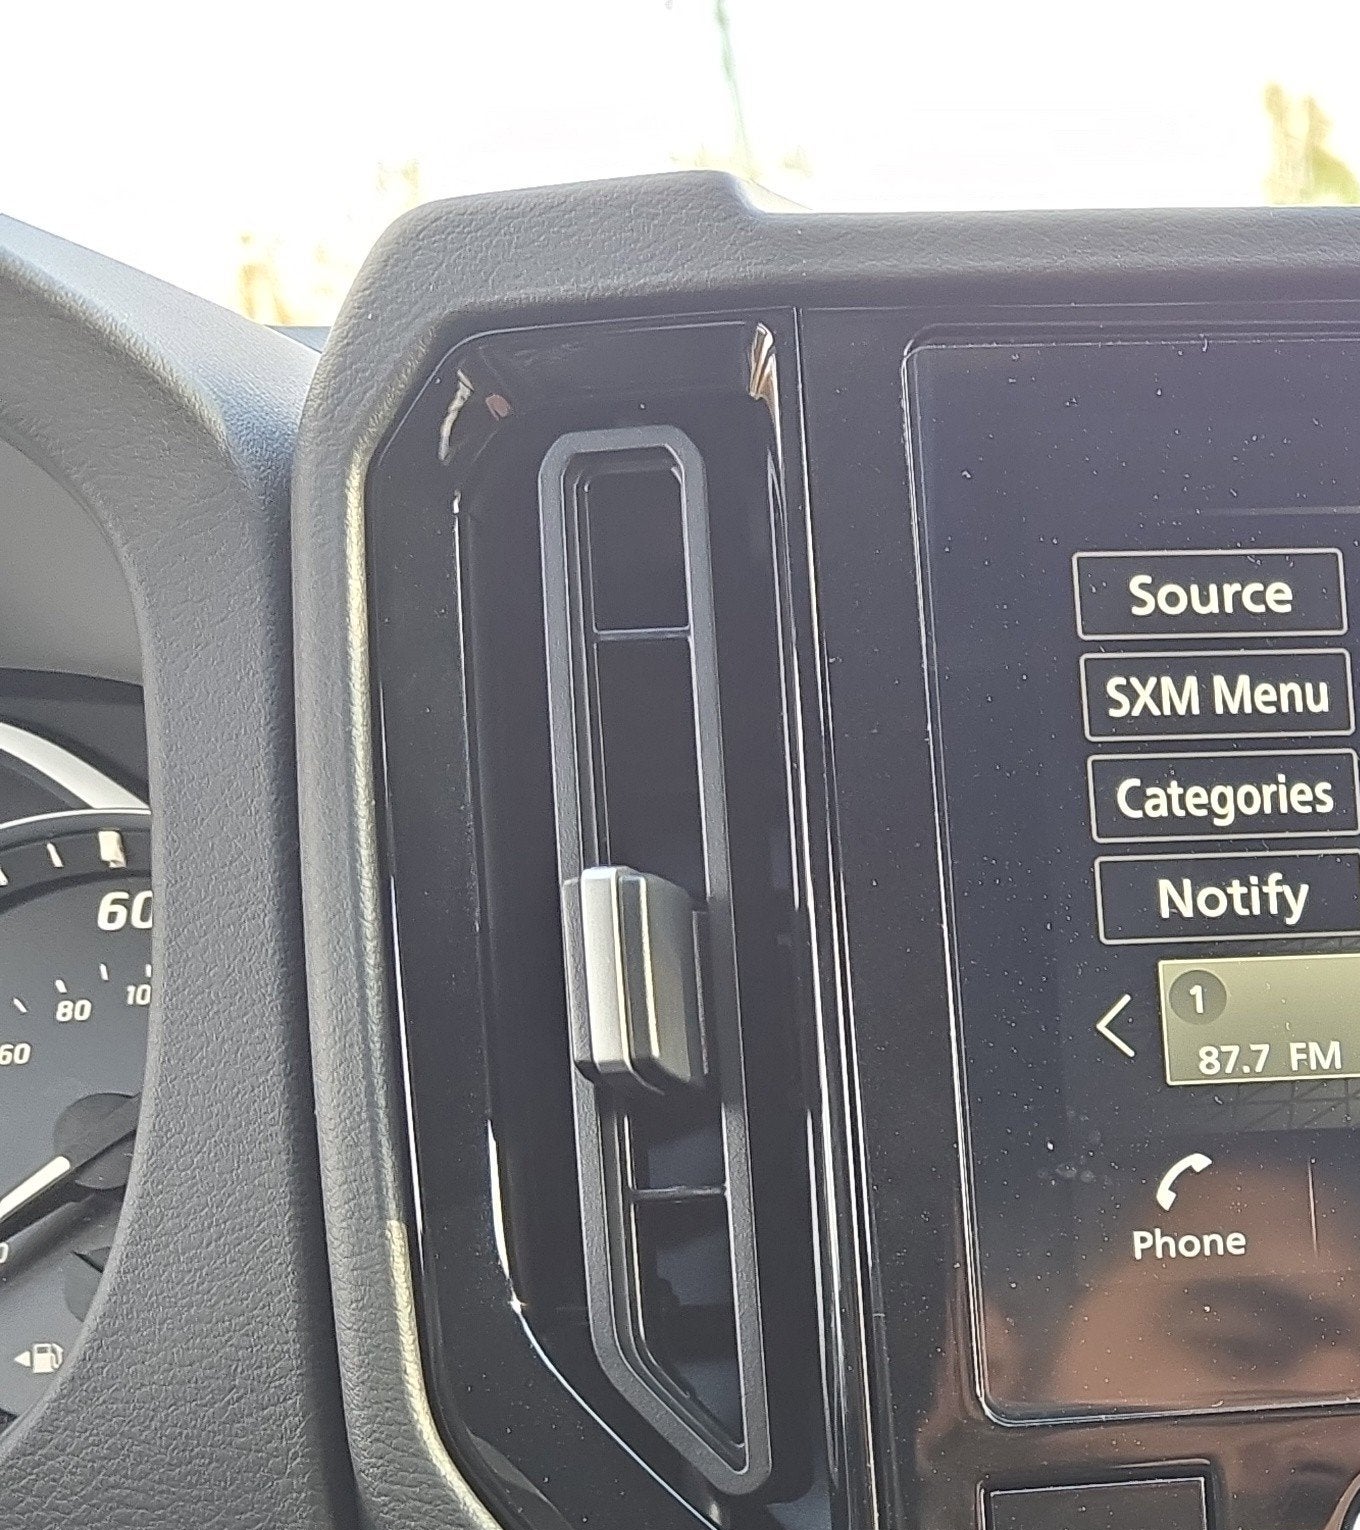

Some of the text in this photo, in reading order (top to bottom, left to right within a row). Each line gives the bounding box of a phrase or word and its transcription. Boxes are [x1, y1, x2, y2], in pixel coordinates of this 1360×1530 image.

[1129, 574, 1294, 617] Source
[1106, 674, 1330, 718] SXM Menu
[1116, 775, 1334, 826] Categories
[97, 890, 153, 931] 60
[1159, 873, 1310, 924] Notify
[56, 999, 92, 1022] 80
[126, 983, 151, 1006] 10
[1189, 985, 1203, 1014] 1
[0, 1043, 31, 1065] 60
[1198, 1041, 1342, 1076] 87.7 FM
[1133, 1227, 1246, 1261] Phone
